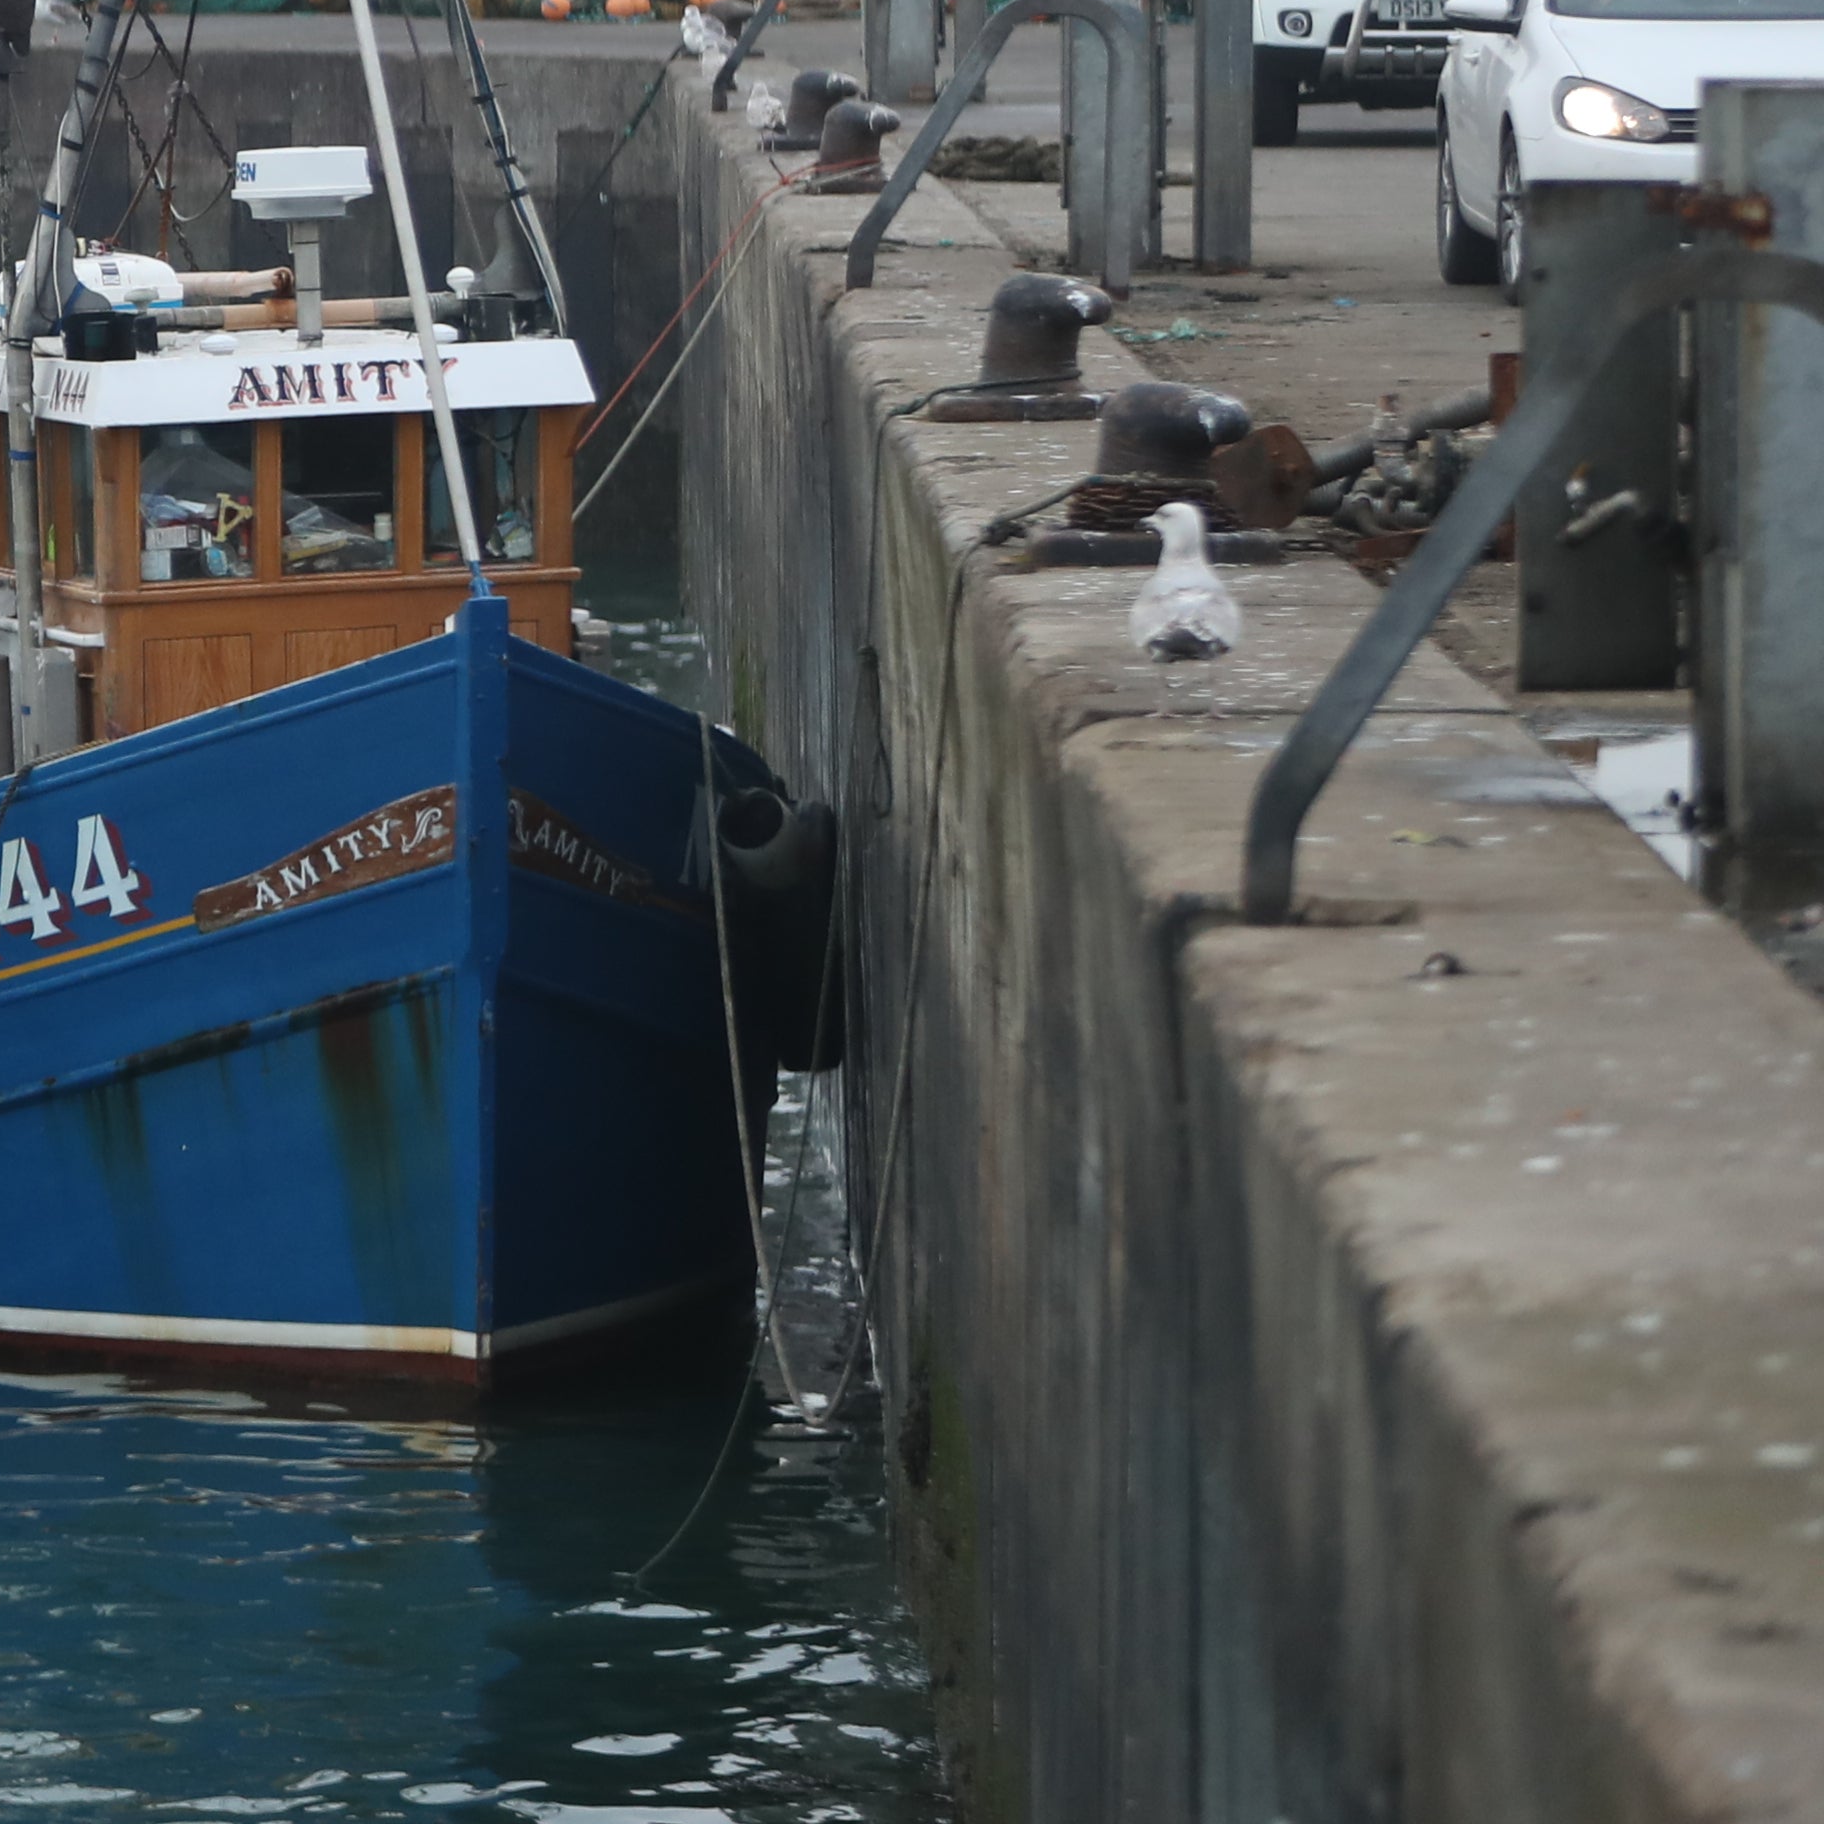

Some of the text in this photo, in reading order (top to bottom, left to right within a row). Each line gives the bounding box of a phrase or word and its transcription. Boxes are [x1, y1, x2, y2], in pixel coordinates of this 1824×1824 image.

[228, 357, 458, 410] AMITY
[254, 818, 392, 910] AMITY
[533, 819, 624, 896] AMITY
